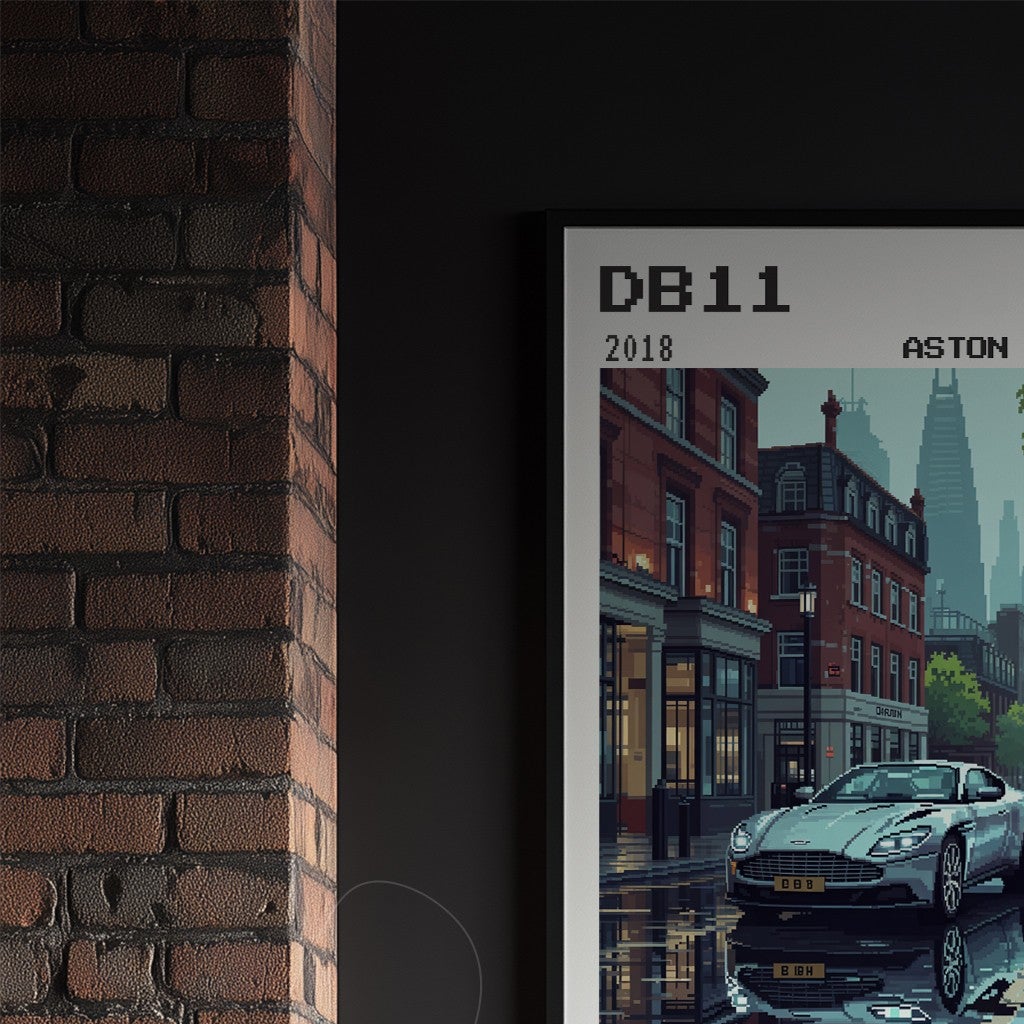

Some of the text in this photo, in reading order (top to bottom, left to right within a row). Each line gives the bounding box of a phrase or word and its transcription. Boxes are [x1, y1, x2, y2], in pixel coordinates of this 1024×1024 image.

[599, 265, 791, 313] DB11
[605, 334, 673, 362] 2018
[902, 336, 1008, 359] ASTON
